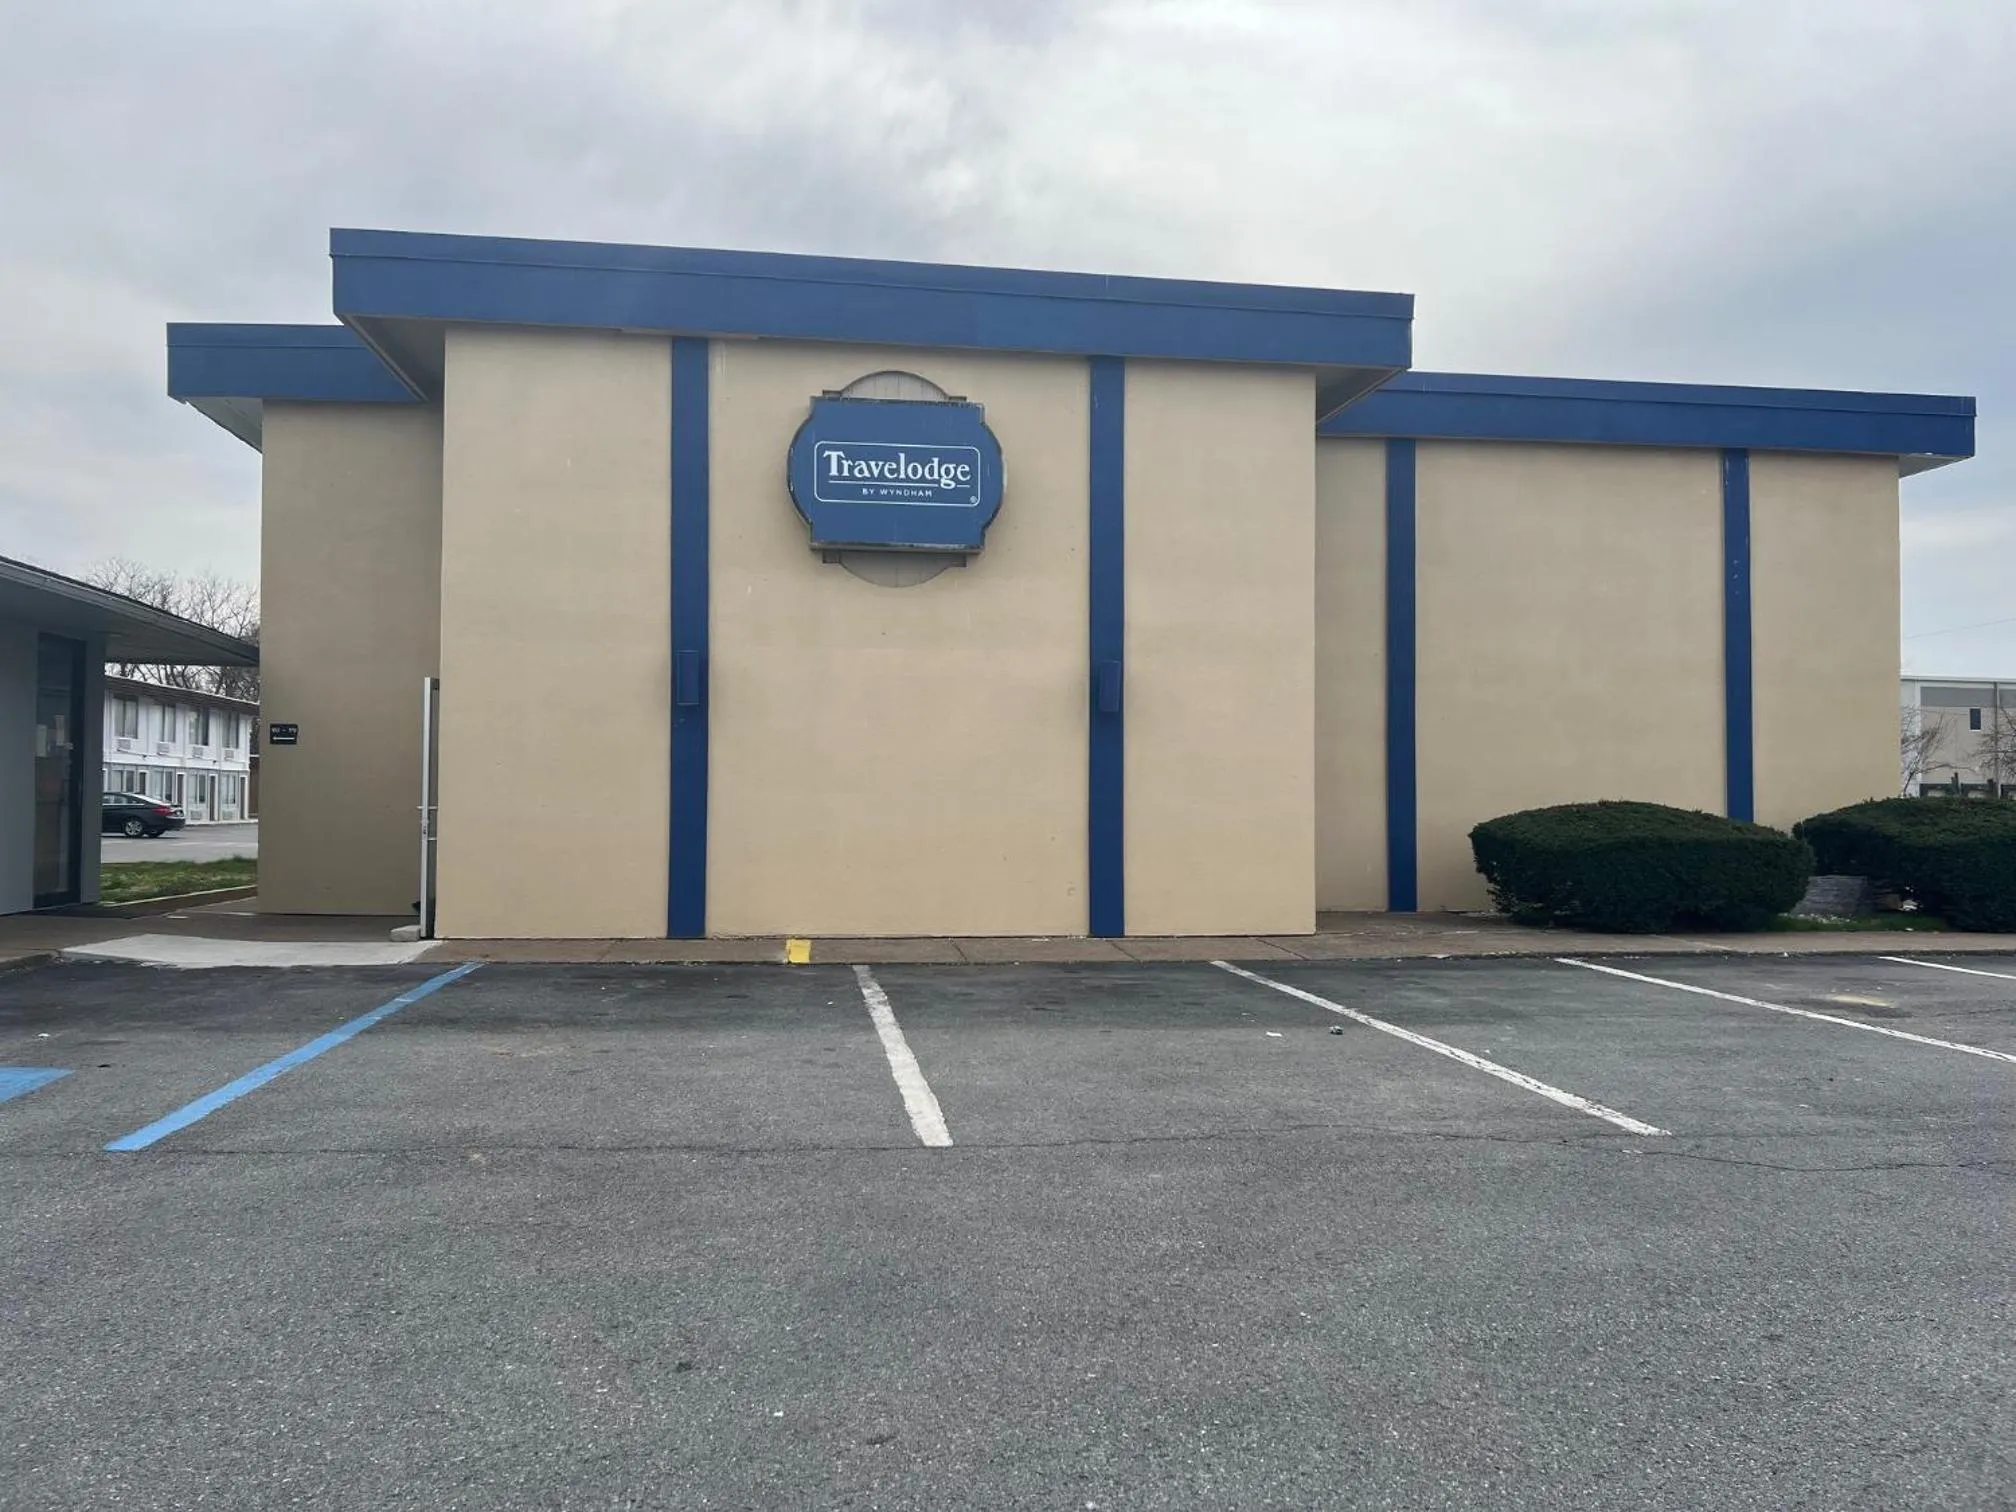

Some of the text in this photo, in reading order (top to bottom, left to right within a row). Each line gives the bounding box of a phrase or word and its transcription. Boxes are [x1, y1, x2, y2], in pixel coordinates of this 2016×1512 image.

[823, 450, 971, 489] Travelodge
[862, 487, 933, 498] BY WYNDHAM
